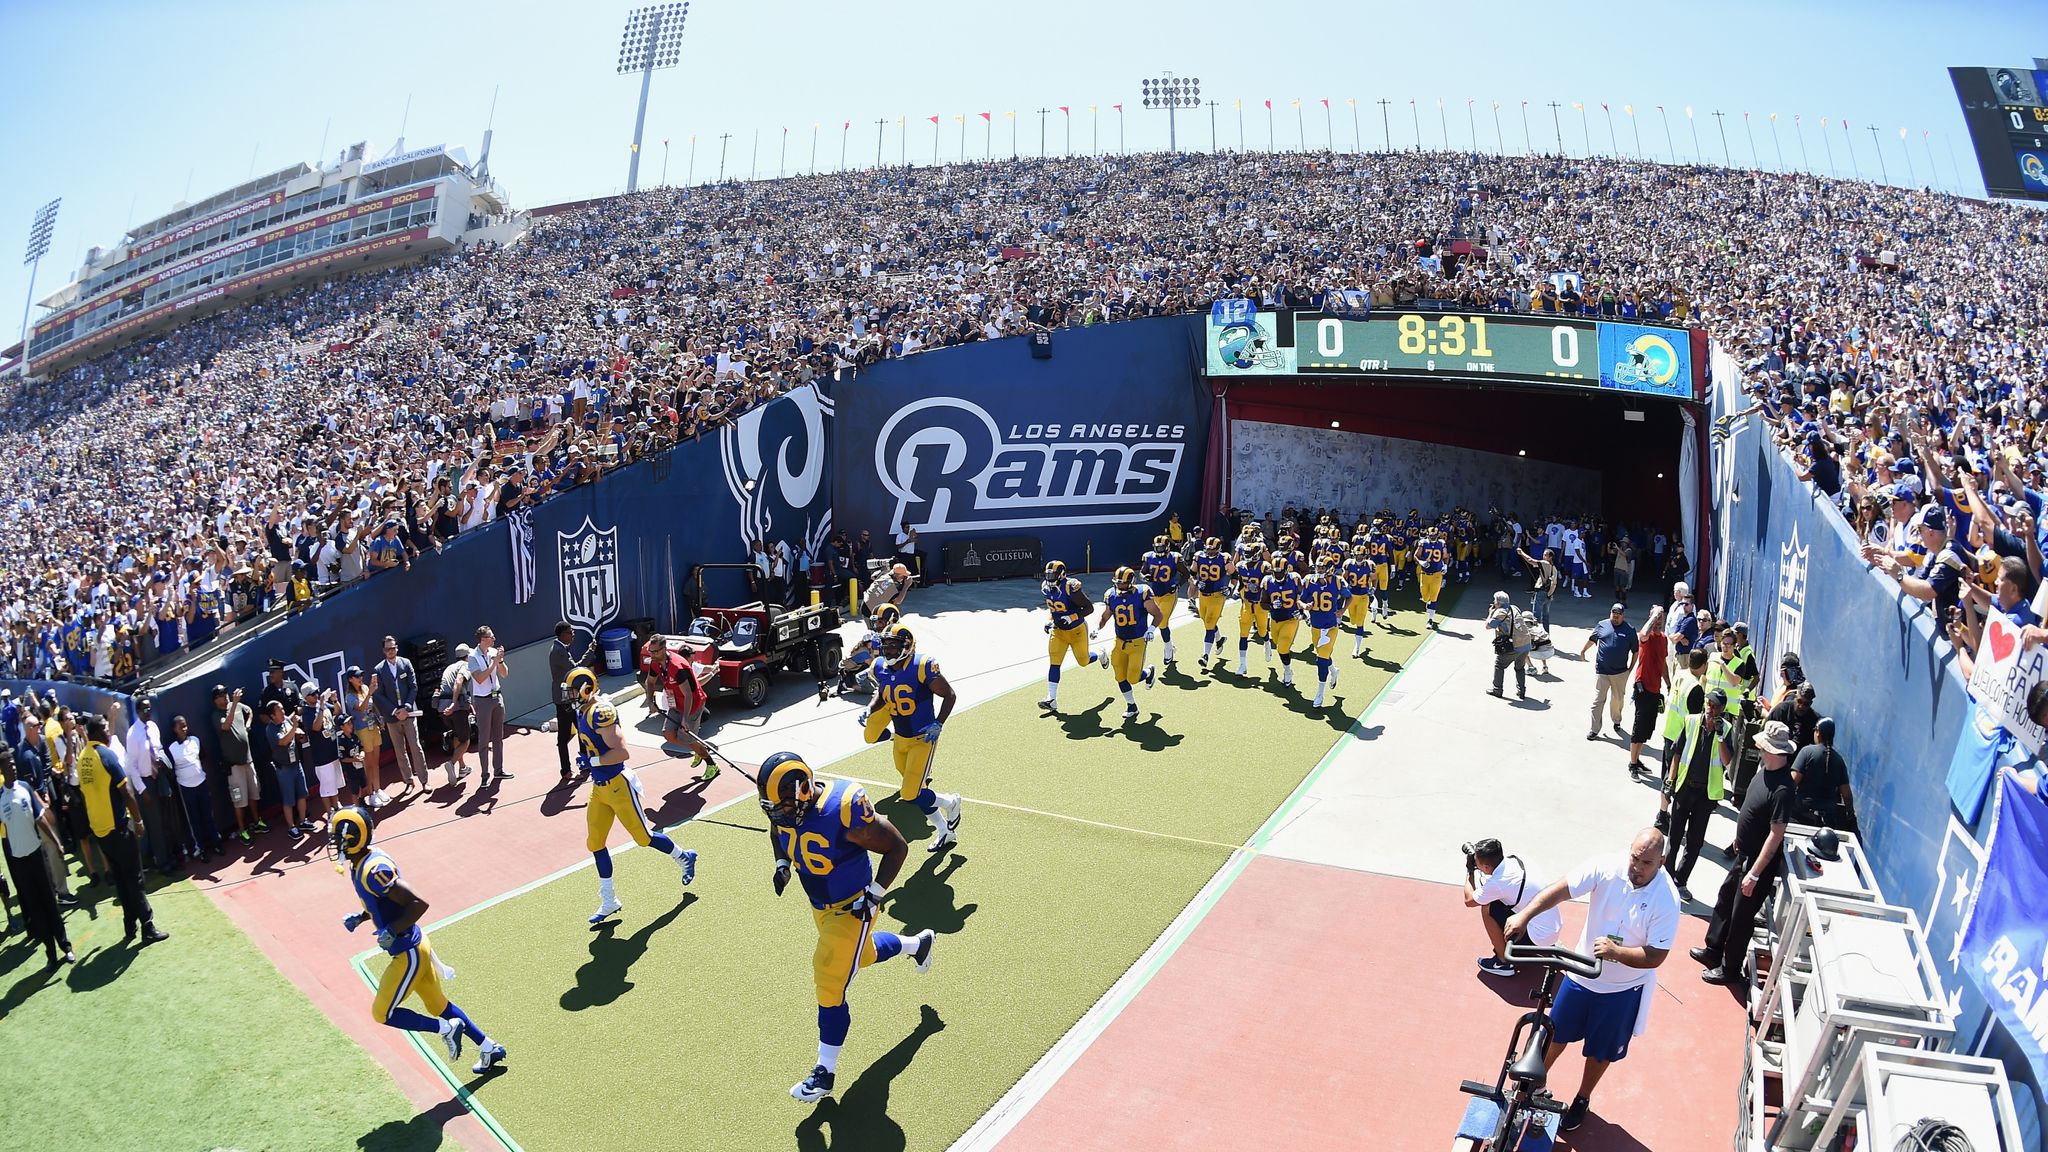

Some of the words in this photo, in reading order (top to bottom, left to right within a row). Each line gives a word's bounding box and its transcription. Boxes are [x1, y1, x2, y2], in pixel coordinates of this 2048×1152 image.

[2010, 111, 2024, 130] 0
[371, 159, 390, 169] BANC
[402, 146, 442, 161] CALIFORNIA
[141, 243, 153, 253] WE
[154, 234, 175, 248] PLAY
[175, 226, 193, 240] FOR
[194, 197, 271, 232] CHAMPIONSHIPS
[158, 260, 200, 281] NATIONAL
[201, 240, 257, 264] CHAMPIONS
[264, 230, 286, 242] 1972
[294, 221, 317, 233] 1974
[357, 201, 383, 214] 2003
[392, 192, 420, 204] 2004
[175, 297, 196, 310] ROSE
[197, 287, 225, 302] BOWLS
[1220, 300, 1249, 324] 12
[1317, 318, 1344, 358] 0
[1398, 314, 1493, 357] 8:31
[1551, 325, 1579, 368] 0
[1359, 359, 1380, 372] QTR
[1382, 360, 1388, 370] 1
[1466, 361, 1479, 372] ON
[1479, 362, 1496, 373] THE
[1009, 424, 1062, 439] LOS
[1069, 424, 1186, 439] ANGELES
[985, 551, 1033, 562] COLISEUM
[1370, 542, 1387, 556] 84
[1425, 549, 1442, 562] 79
[1149, 564, 1172, 582] 73
[1199, 564, 1221, 581] 69
[1349, 572, 1368, 588] 34
[567, 568, 615, 621] NFL
[1311, 590, 1333, 612] 16
[1115, 603, 1137, 627] 61
[882, 684, 916, 716] 46
[1972, 665, 2014, 715] WELCOME
[2014, 701, 2045, 744] HOME!
[777, 825, 834, 876] 76
